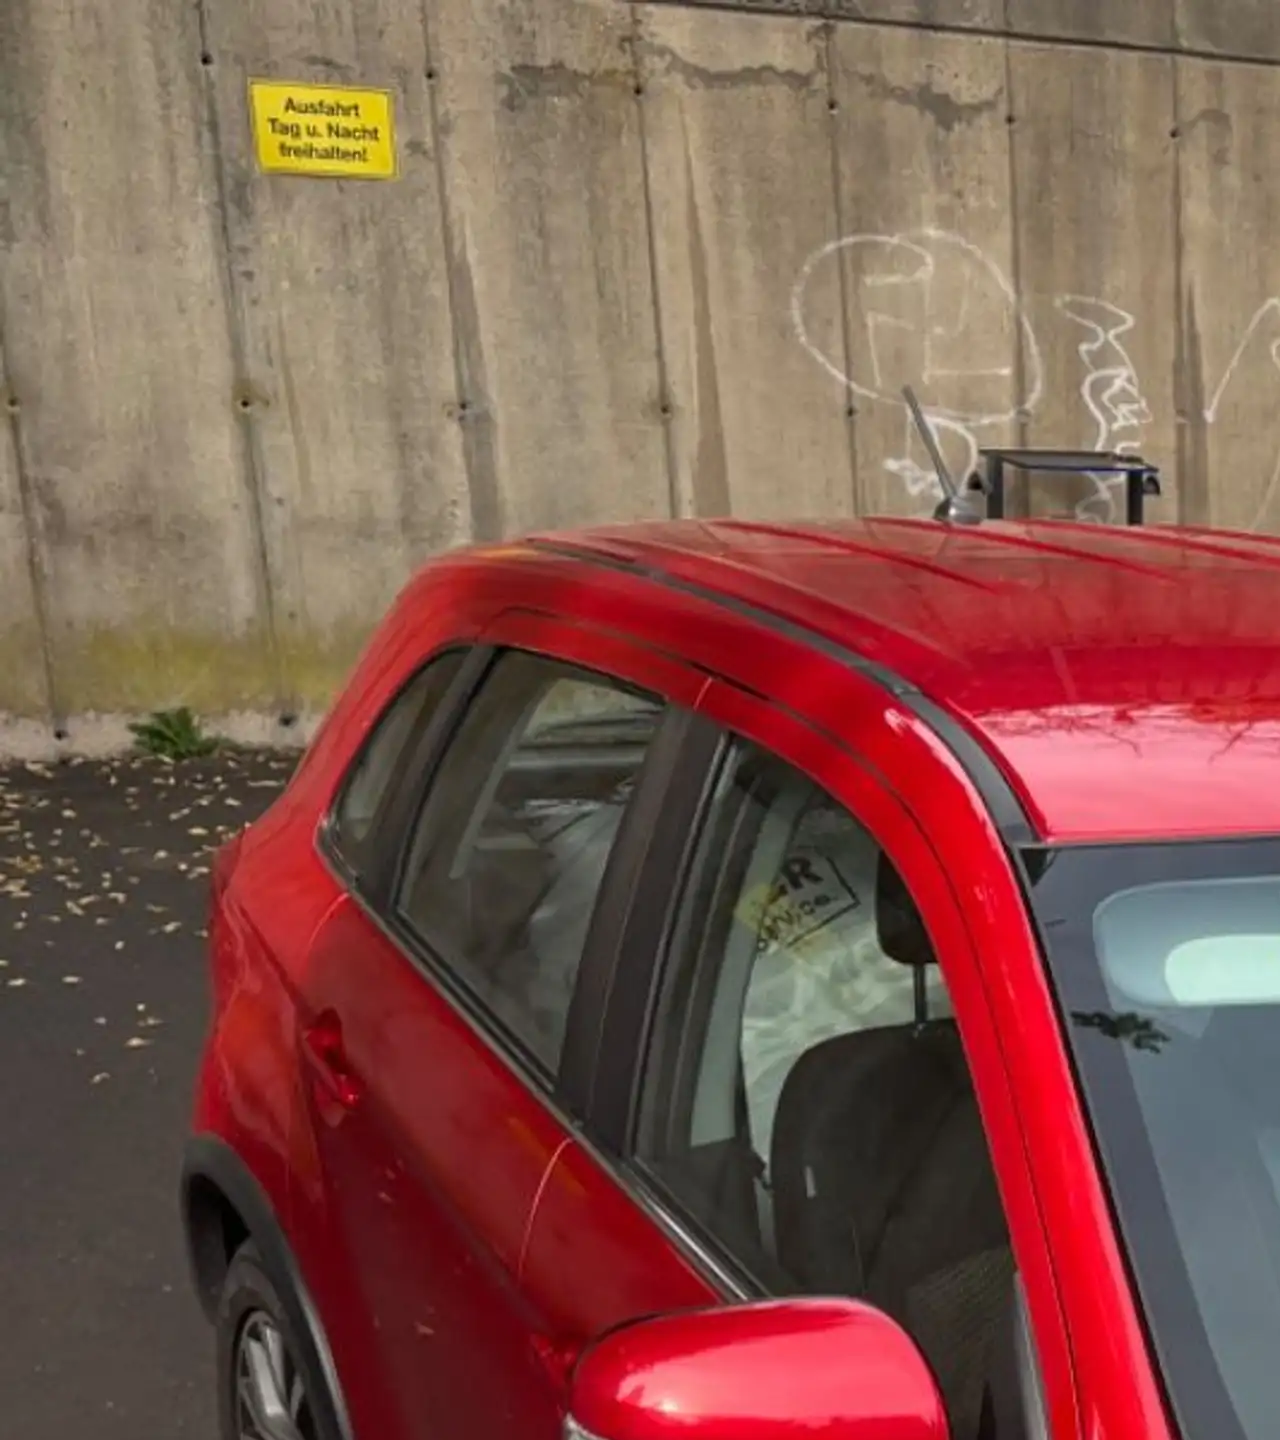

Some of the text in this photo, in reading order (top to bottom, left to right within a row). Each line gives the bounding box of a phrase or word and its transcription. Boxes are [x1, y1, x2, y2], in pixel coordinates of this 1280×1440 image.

[284, 96, 360, 117] Ausfahrt
[267, 117, 379, 142] Tag u. Nacht
[278, 141, 370, 163] freihalten!
